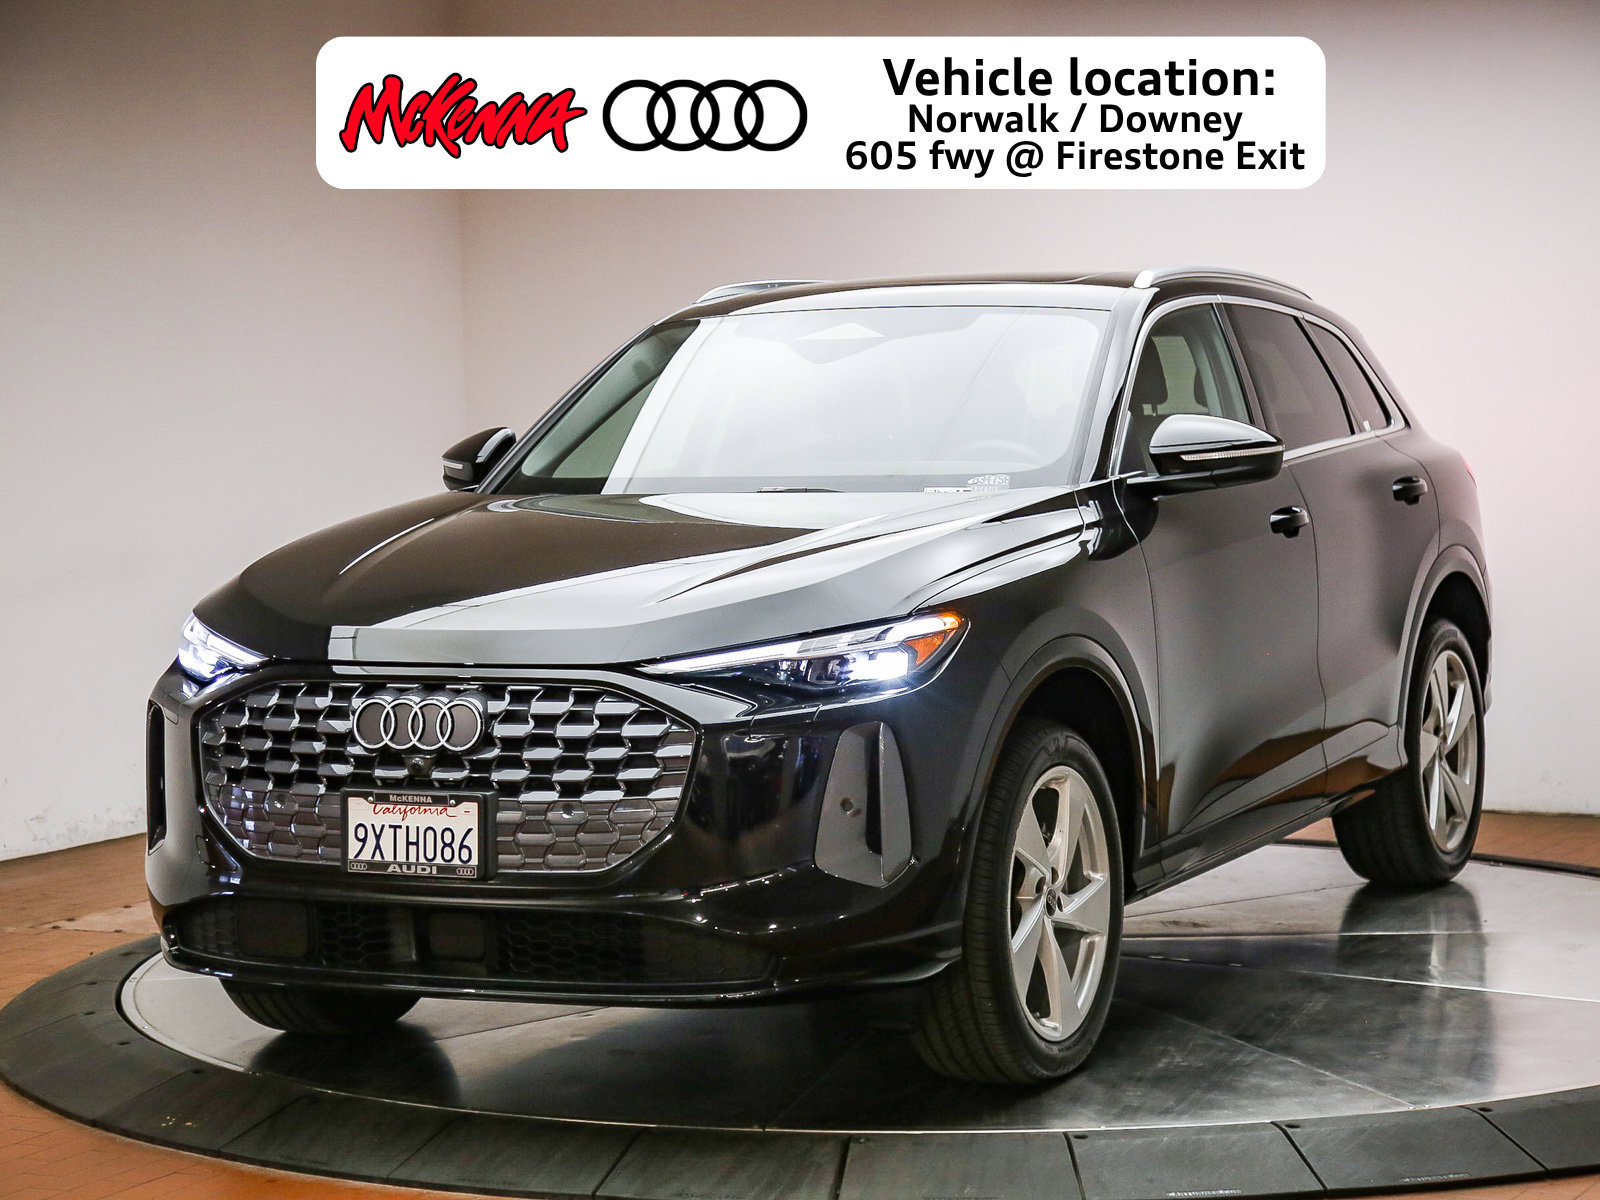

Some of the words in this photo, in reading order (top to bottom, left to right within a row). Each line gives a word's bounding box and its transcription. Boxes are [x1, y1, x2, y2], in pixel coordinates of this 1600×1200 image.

[389, 794, 433, 804] McKENNA
[373, 804, 457, 821] California
[353, 823, 474, 865] 9XTH086
[386, 864, 438, 875] AUDI
